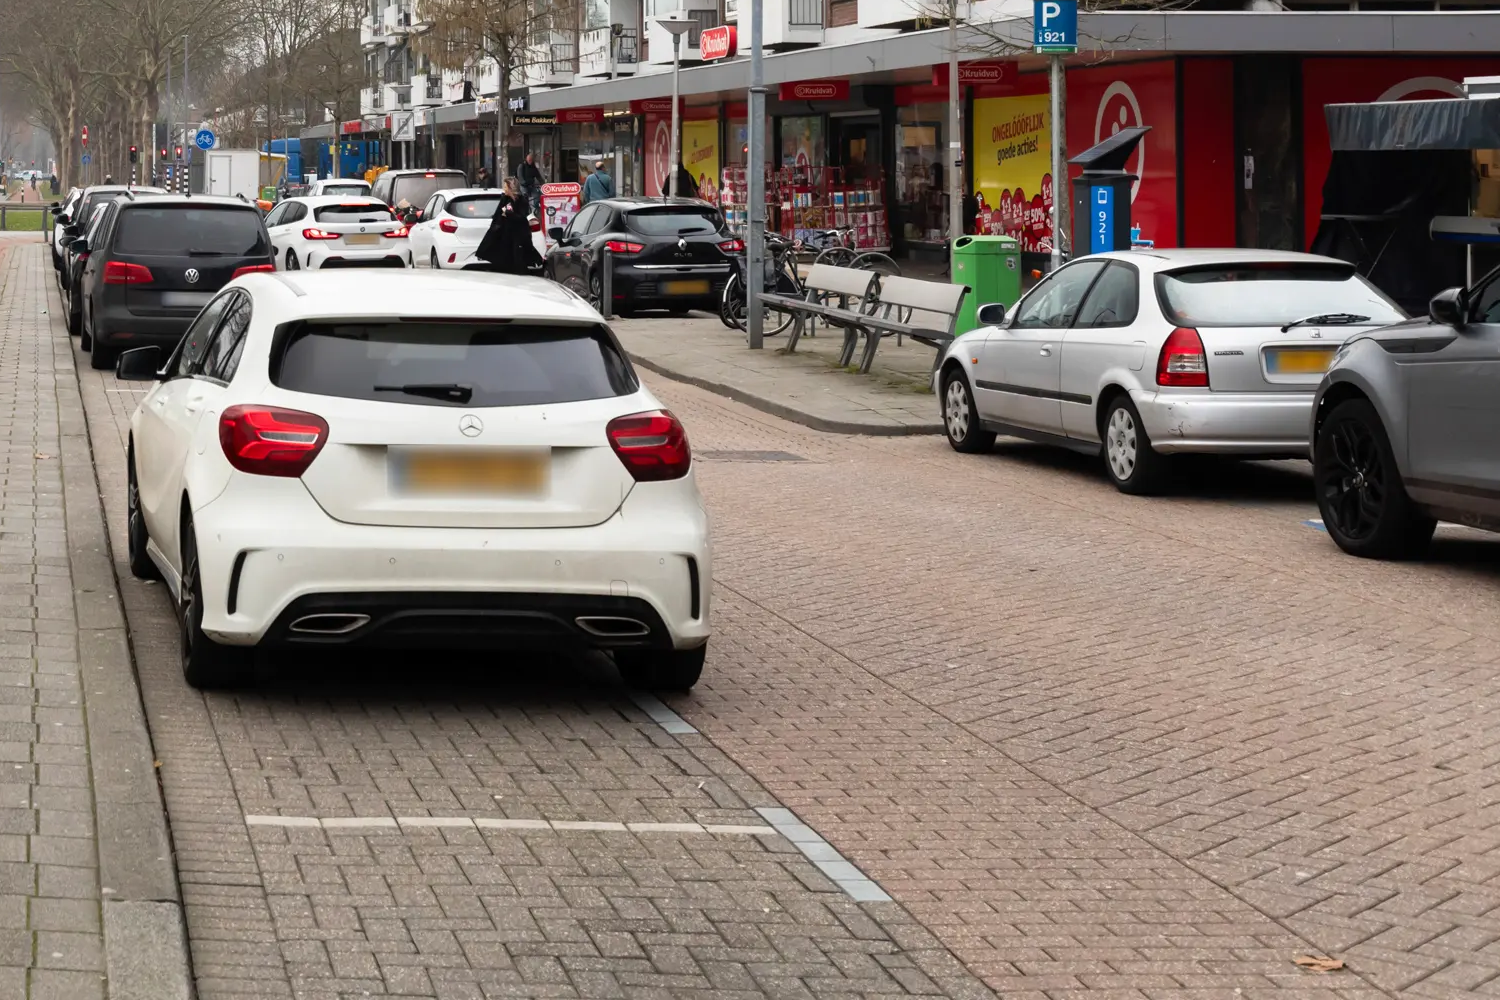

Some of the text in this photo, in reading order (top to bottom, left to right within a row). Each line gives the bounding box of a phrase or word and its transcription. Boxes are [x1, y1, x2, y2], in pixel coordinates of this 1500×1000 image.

[1042, 2, 1061, 27] P
[706, 32, 727, 53] Kruidvat
[1044, 32, 1065, 43] 921
[965, 69, 999, 78] Kruidvat
[805, 87, 833, 95] Kruidvat
[997, 134, 1039, 166] goede acties!
[1098, 211, 1107, 245] 921
